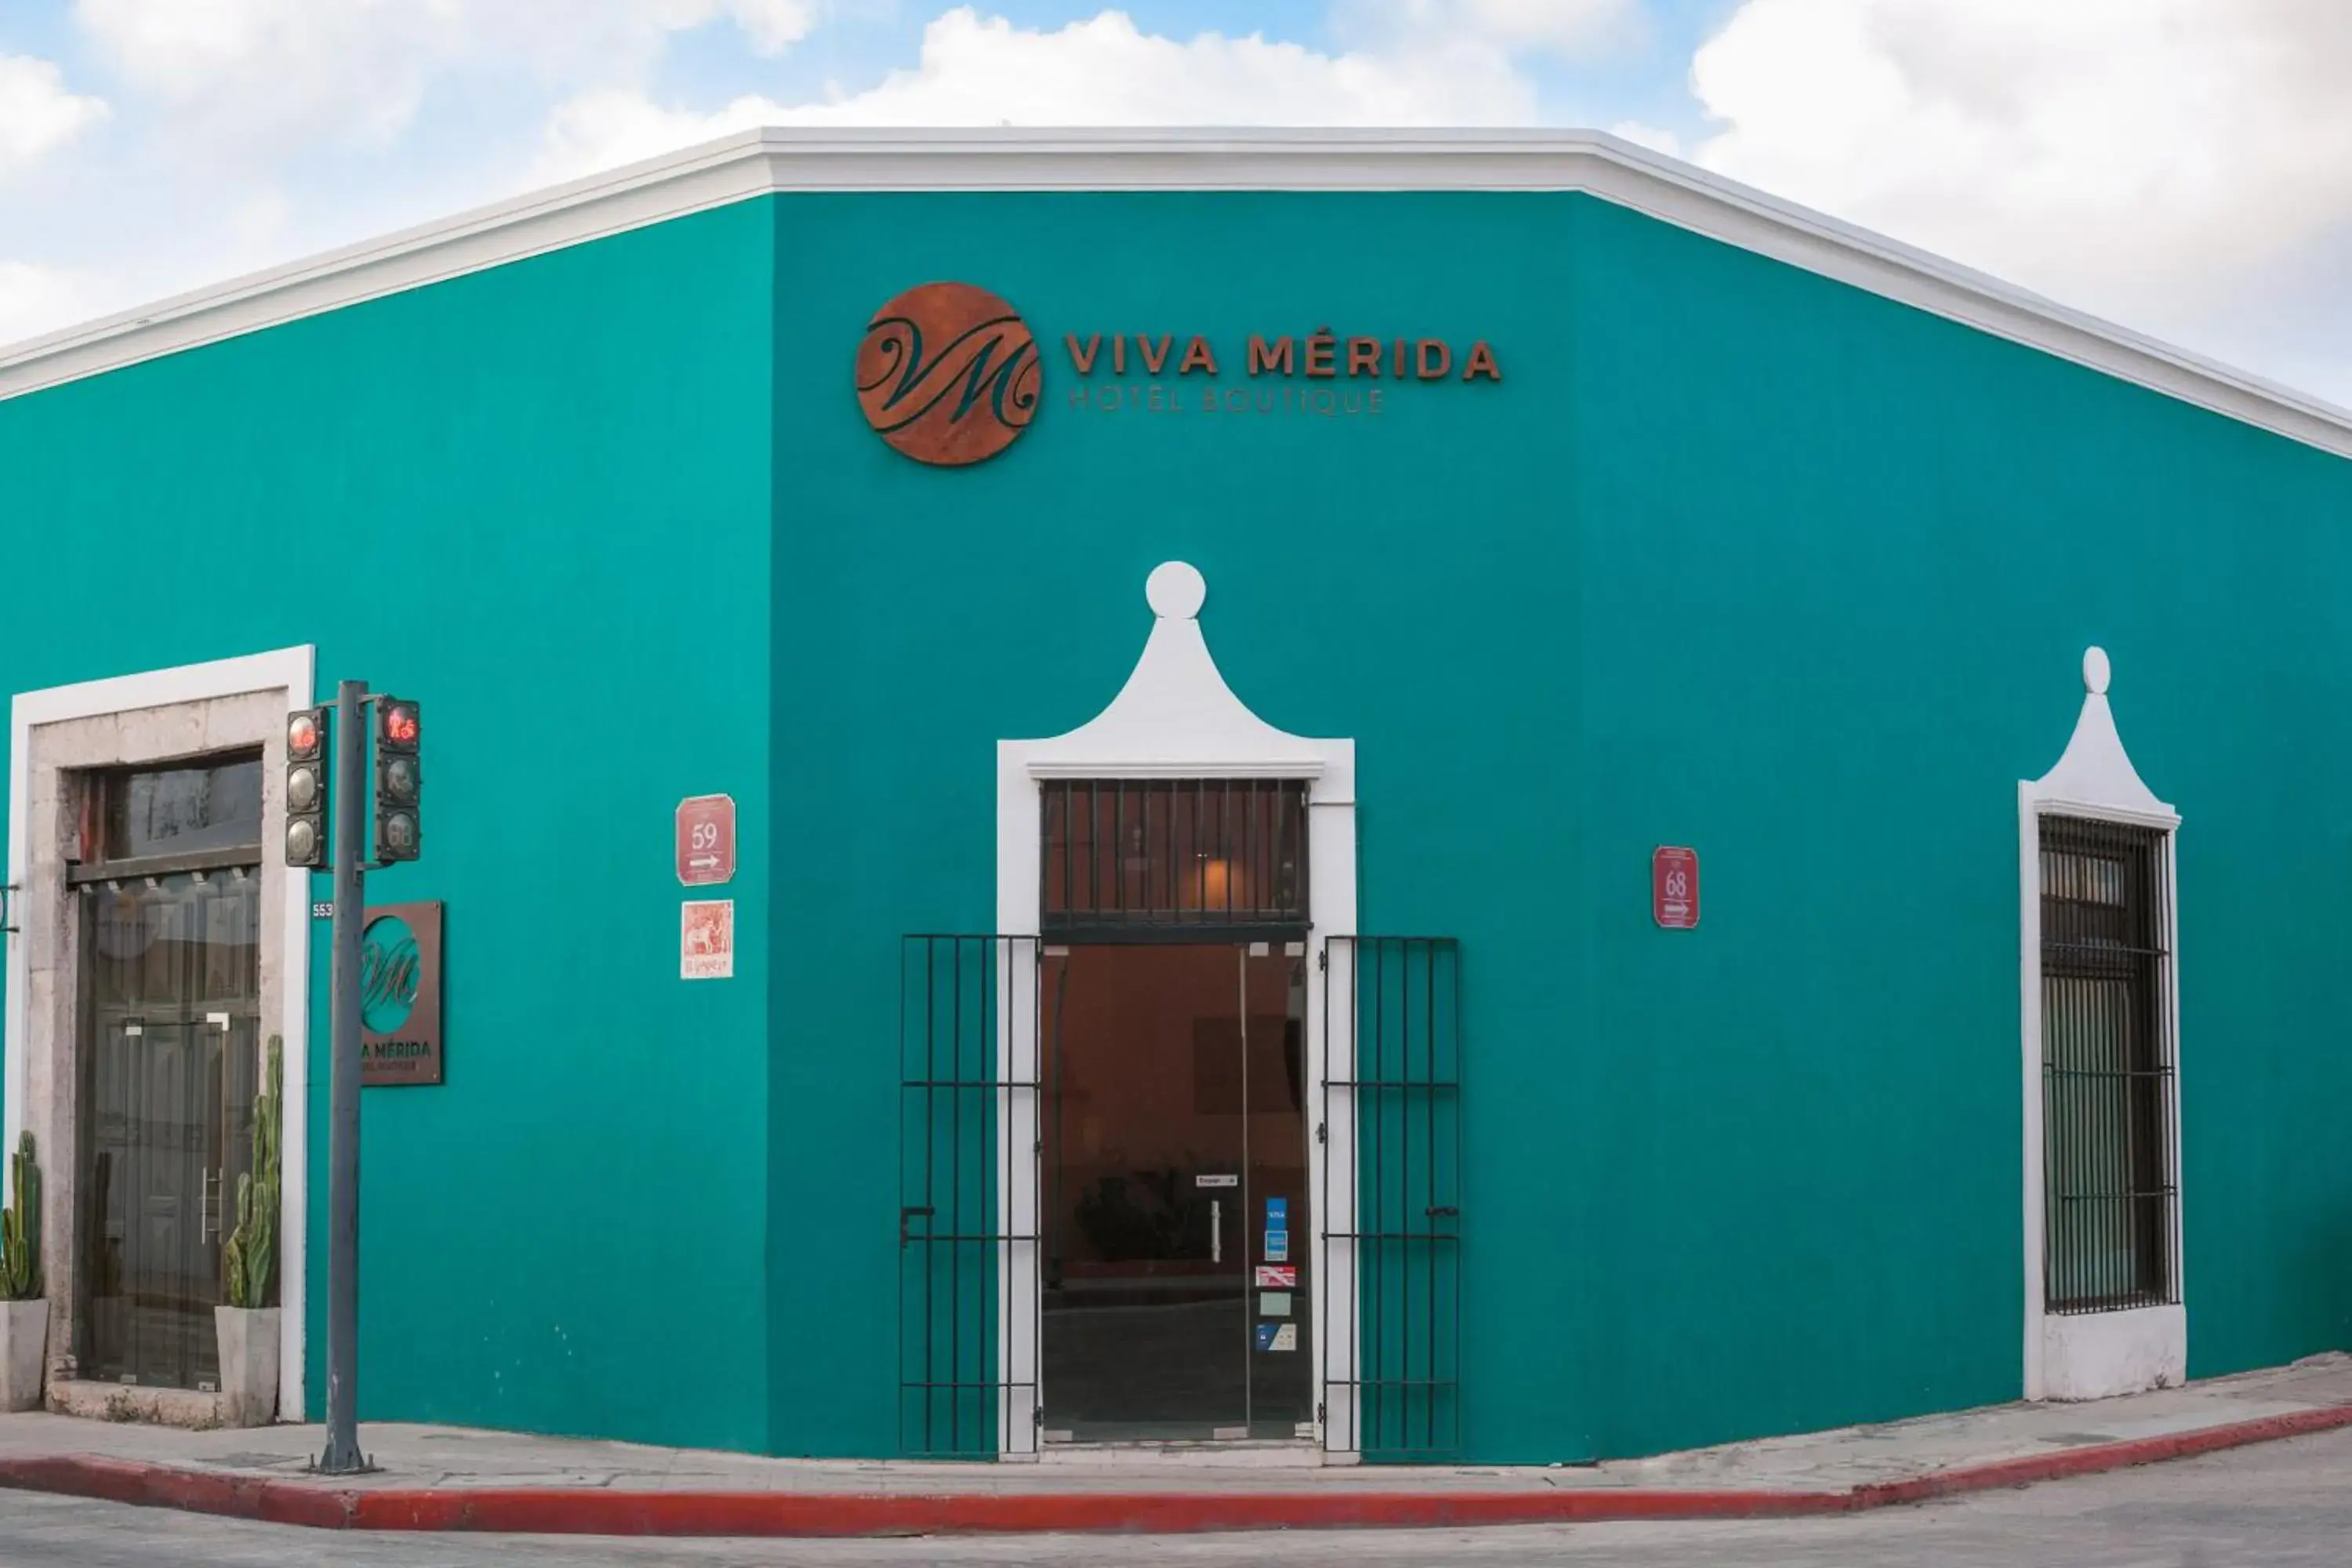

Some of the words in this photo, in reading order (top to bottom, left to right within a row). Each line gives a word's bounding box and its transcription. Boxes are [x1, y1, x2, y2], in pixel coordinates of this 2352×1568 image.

[1065, 333, 1218, 376] VIVA
[1248, 326, 1501, 381] MÉRIDA
[1069, 386, 1182, 412] HOTEL
[1202, 389, 1383, 417] BOUTIQUE
[691, 822, 717, 850] 59
[1665, 870, 1686, 896] 68
[314, 903, 333, 916] 553
[375, 1039, 430, 1058] MÉRIDA
